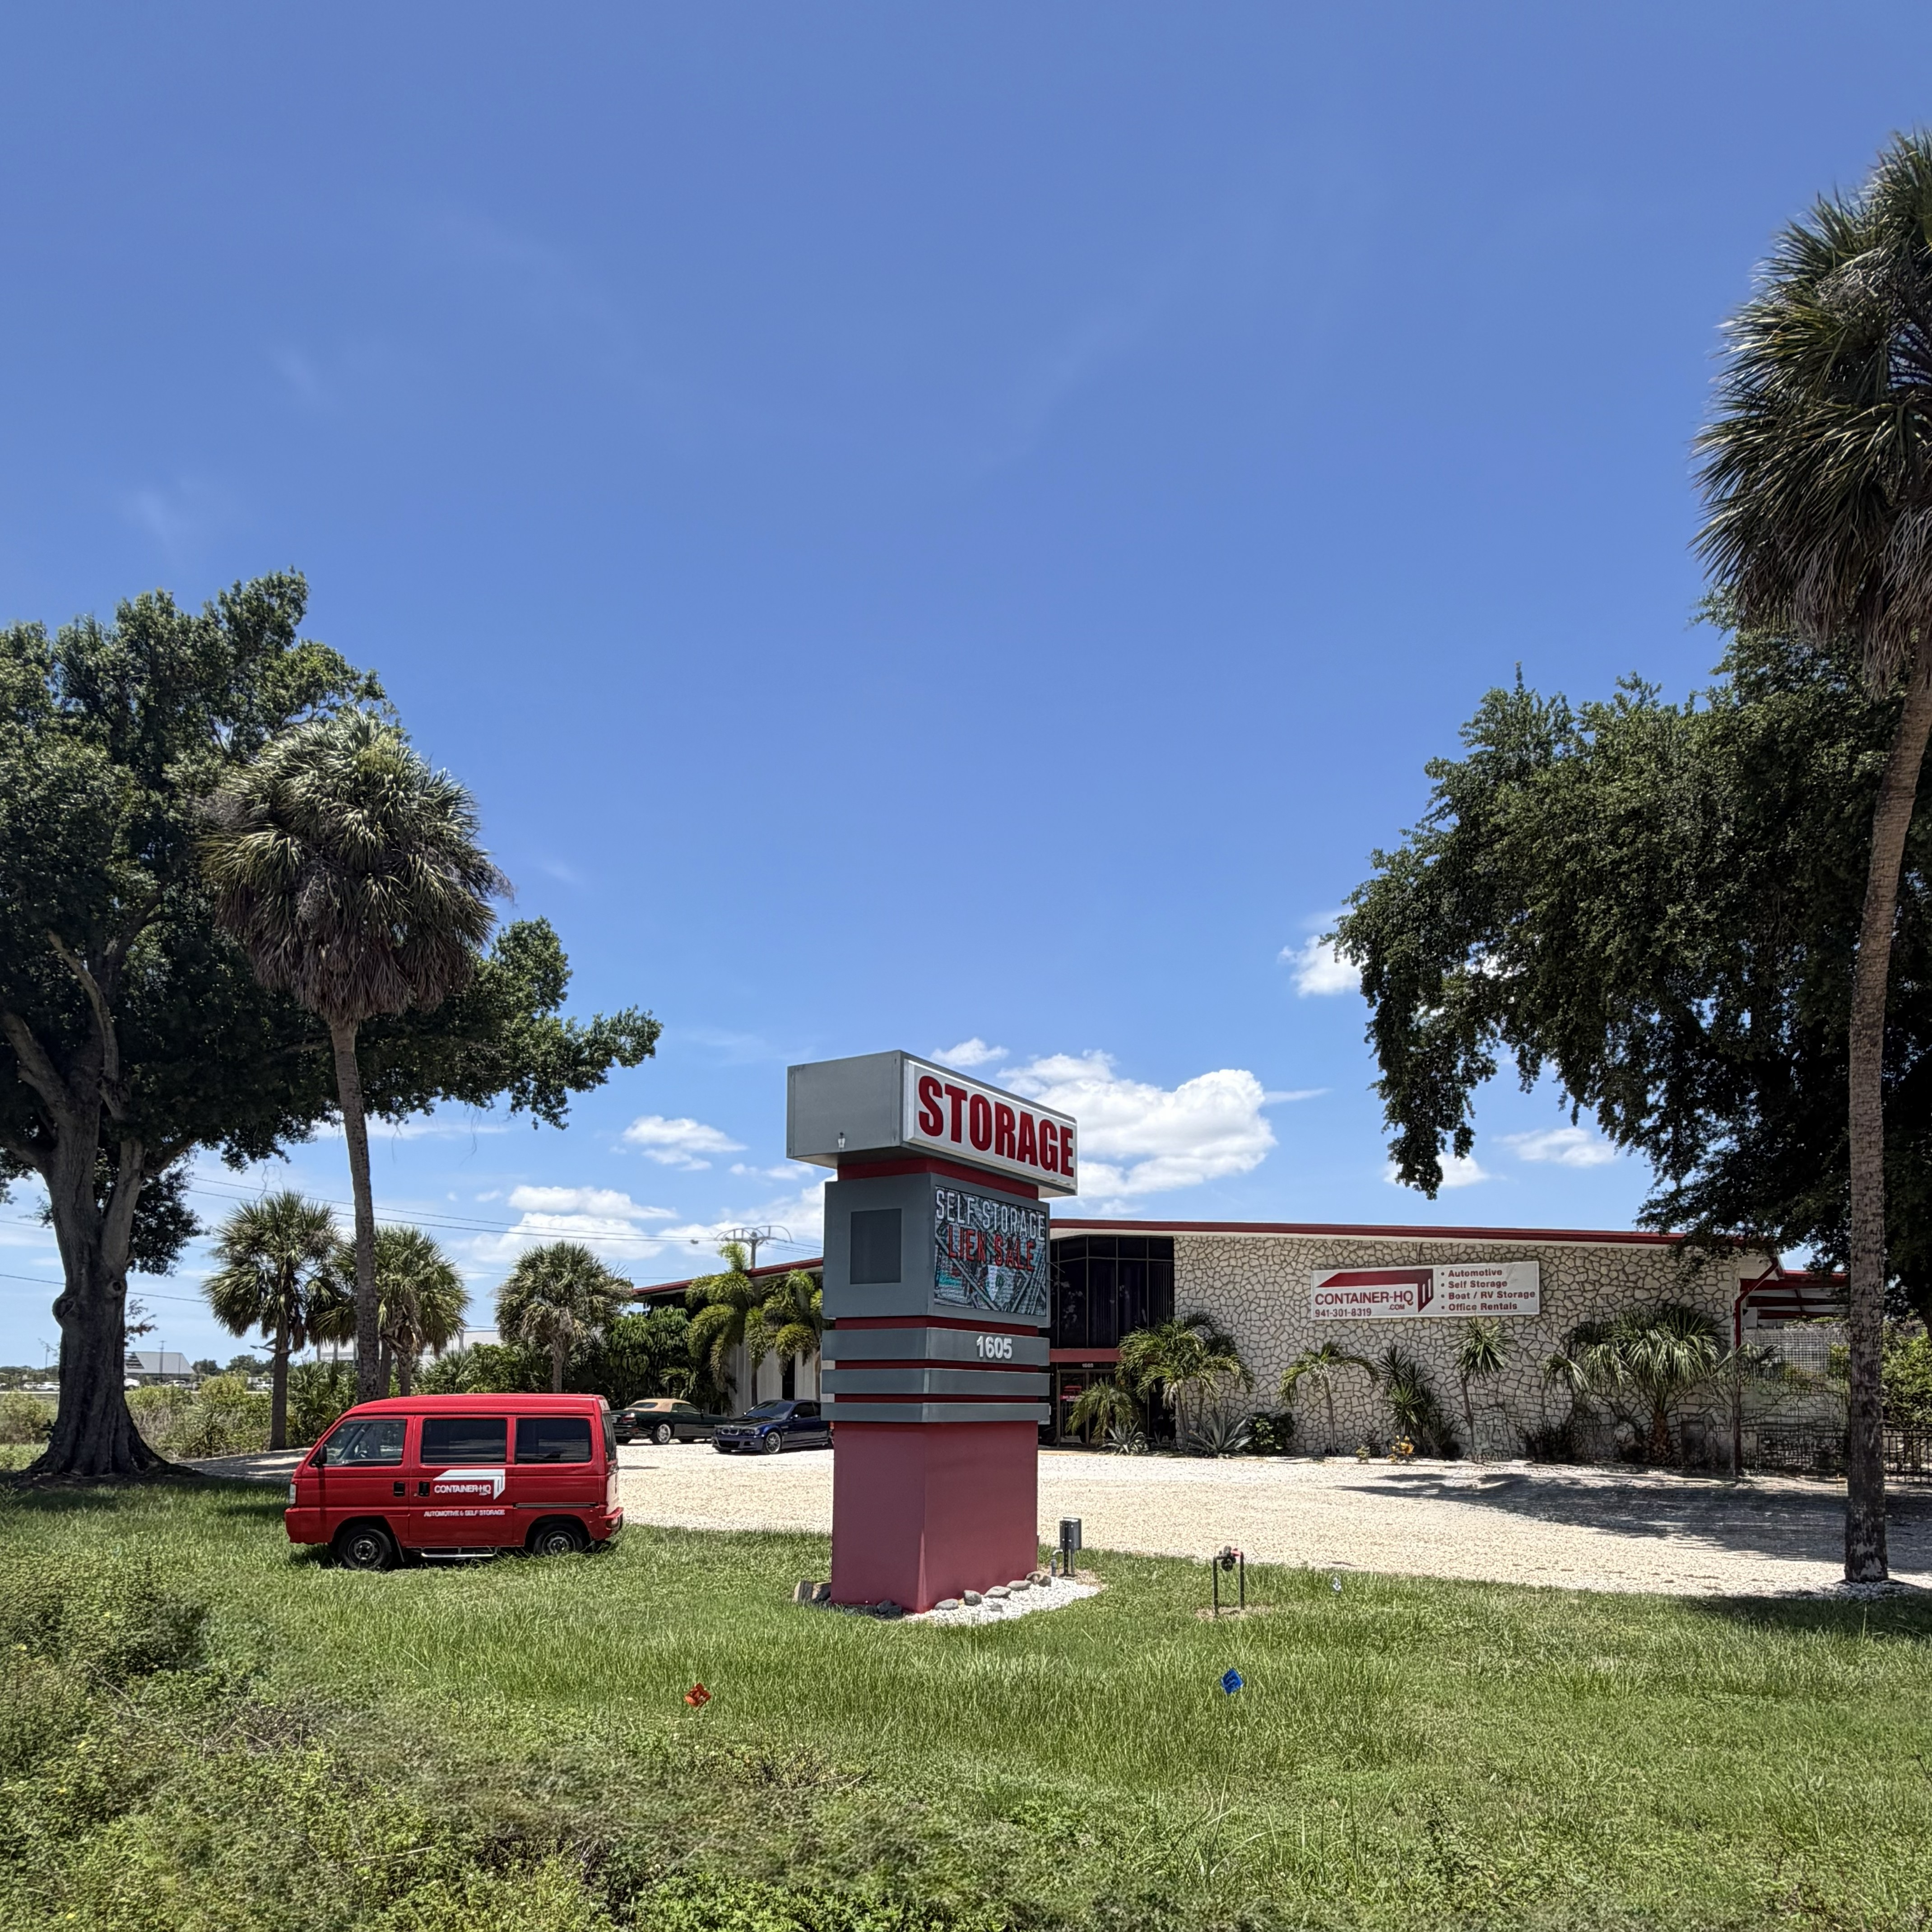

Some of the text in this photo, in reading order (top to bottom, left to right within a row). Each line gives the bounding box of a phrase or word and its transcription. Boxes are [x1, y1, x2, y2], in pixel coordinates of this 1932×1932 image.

[918, 1075, 1074, 1178] STORAGE
[936, 1189, 1045, 1241] SELF STORAGE
[948, 1224, 1036, 1272] LIEN SALE
[1448, 1268, 1502, 1277] Automotive
[1470, 1280, 1508, 1288] Storage
[1315, 1290, 1414, 1305] CONTAINER-HQ
[1497, 1291, 1535, 1299] Storage
[1449, 1302, 1518, 1311] Office Rentals
[1315, 1308, 1372, 1318] 941-301-8319
[977, 1336, 1012, 1359] 1605
[434, 1485, 491, 1494] CONTAINER-HQ
